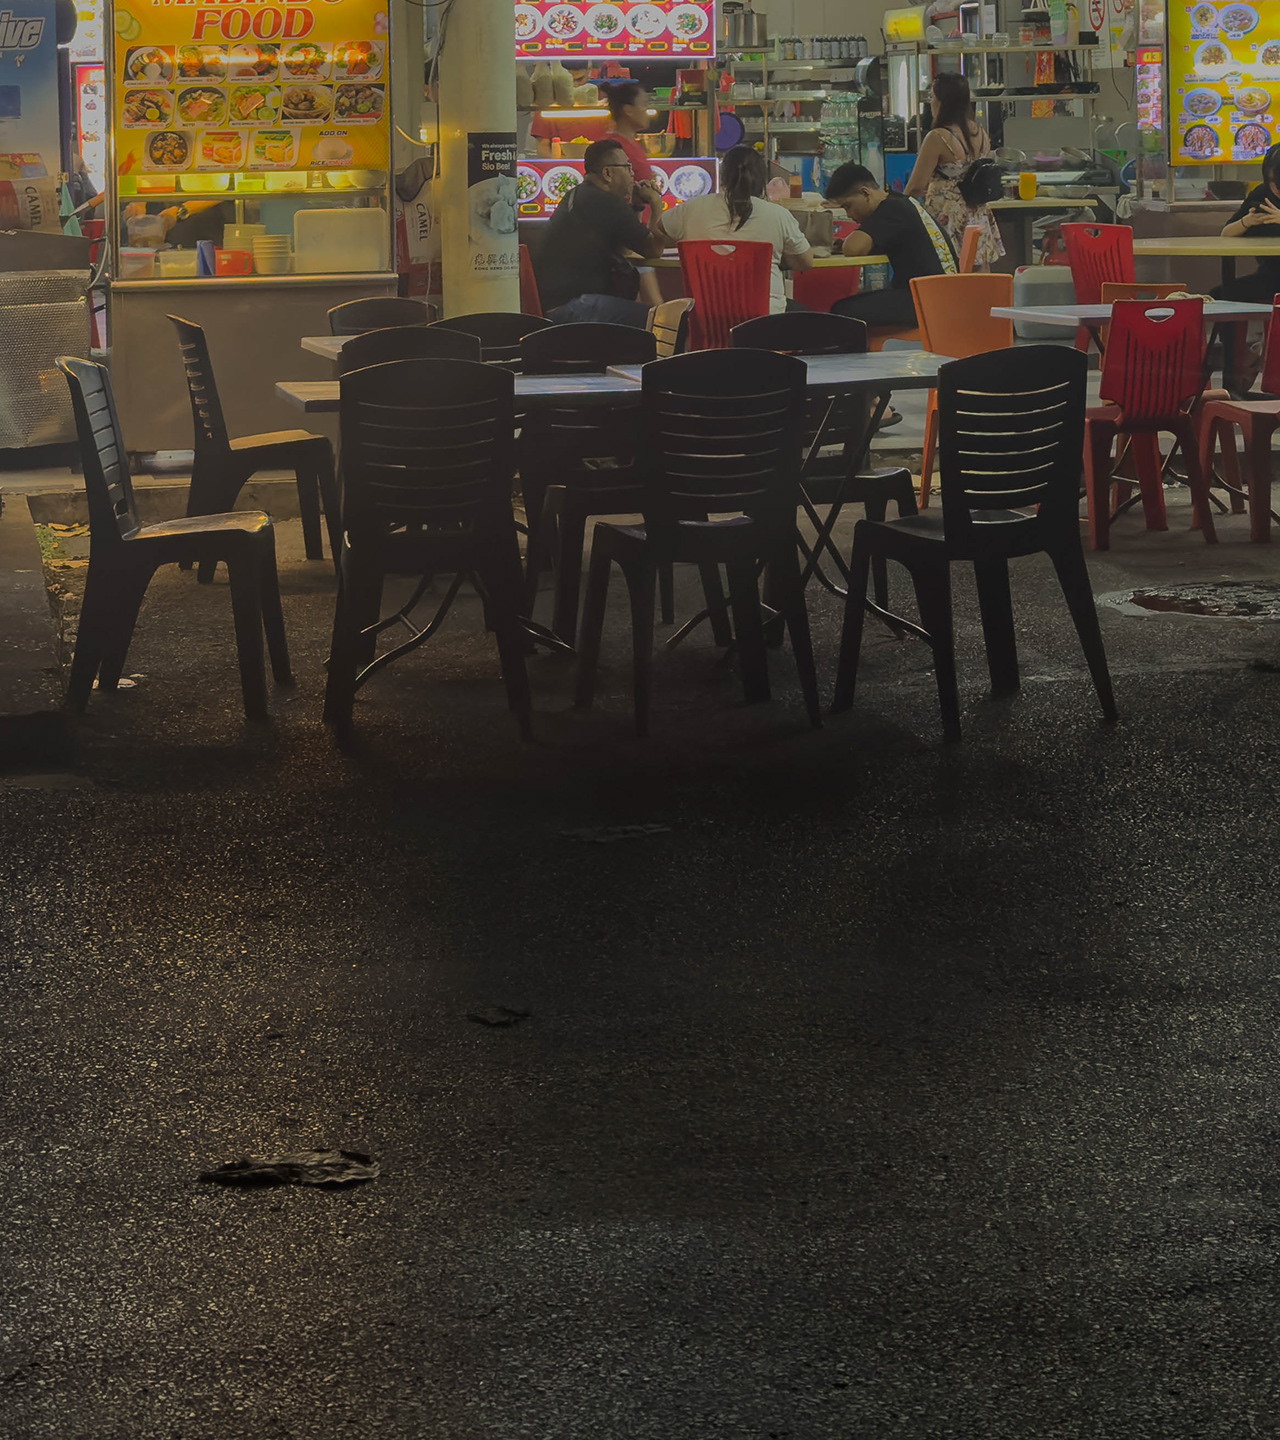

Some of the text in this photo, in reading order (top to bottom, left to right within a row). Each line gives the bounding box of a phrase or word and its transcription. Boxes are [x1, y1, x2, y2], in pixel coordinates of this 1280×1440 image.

[191, 6, 316, 42] FOOD
[481, 149, 513, 161] Fresh
[24, 185, 43, 228] CAMEL
[415, 202, 428, 242] CAMEL
